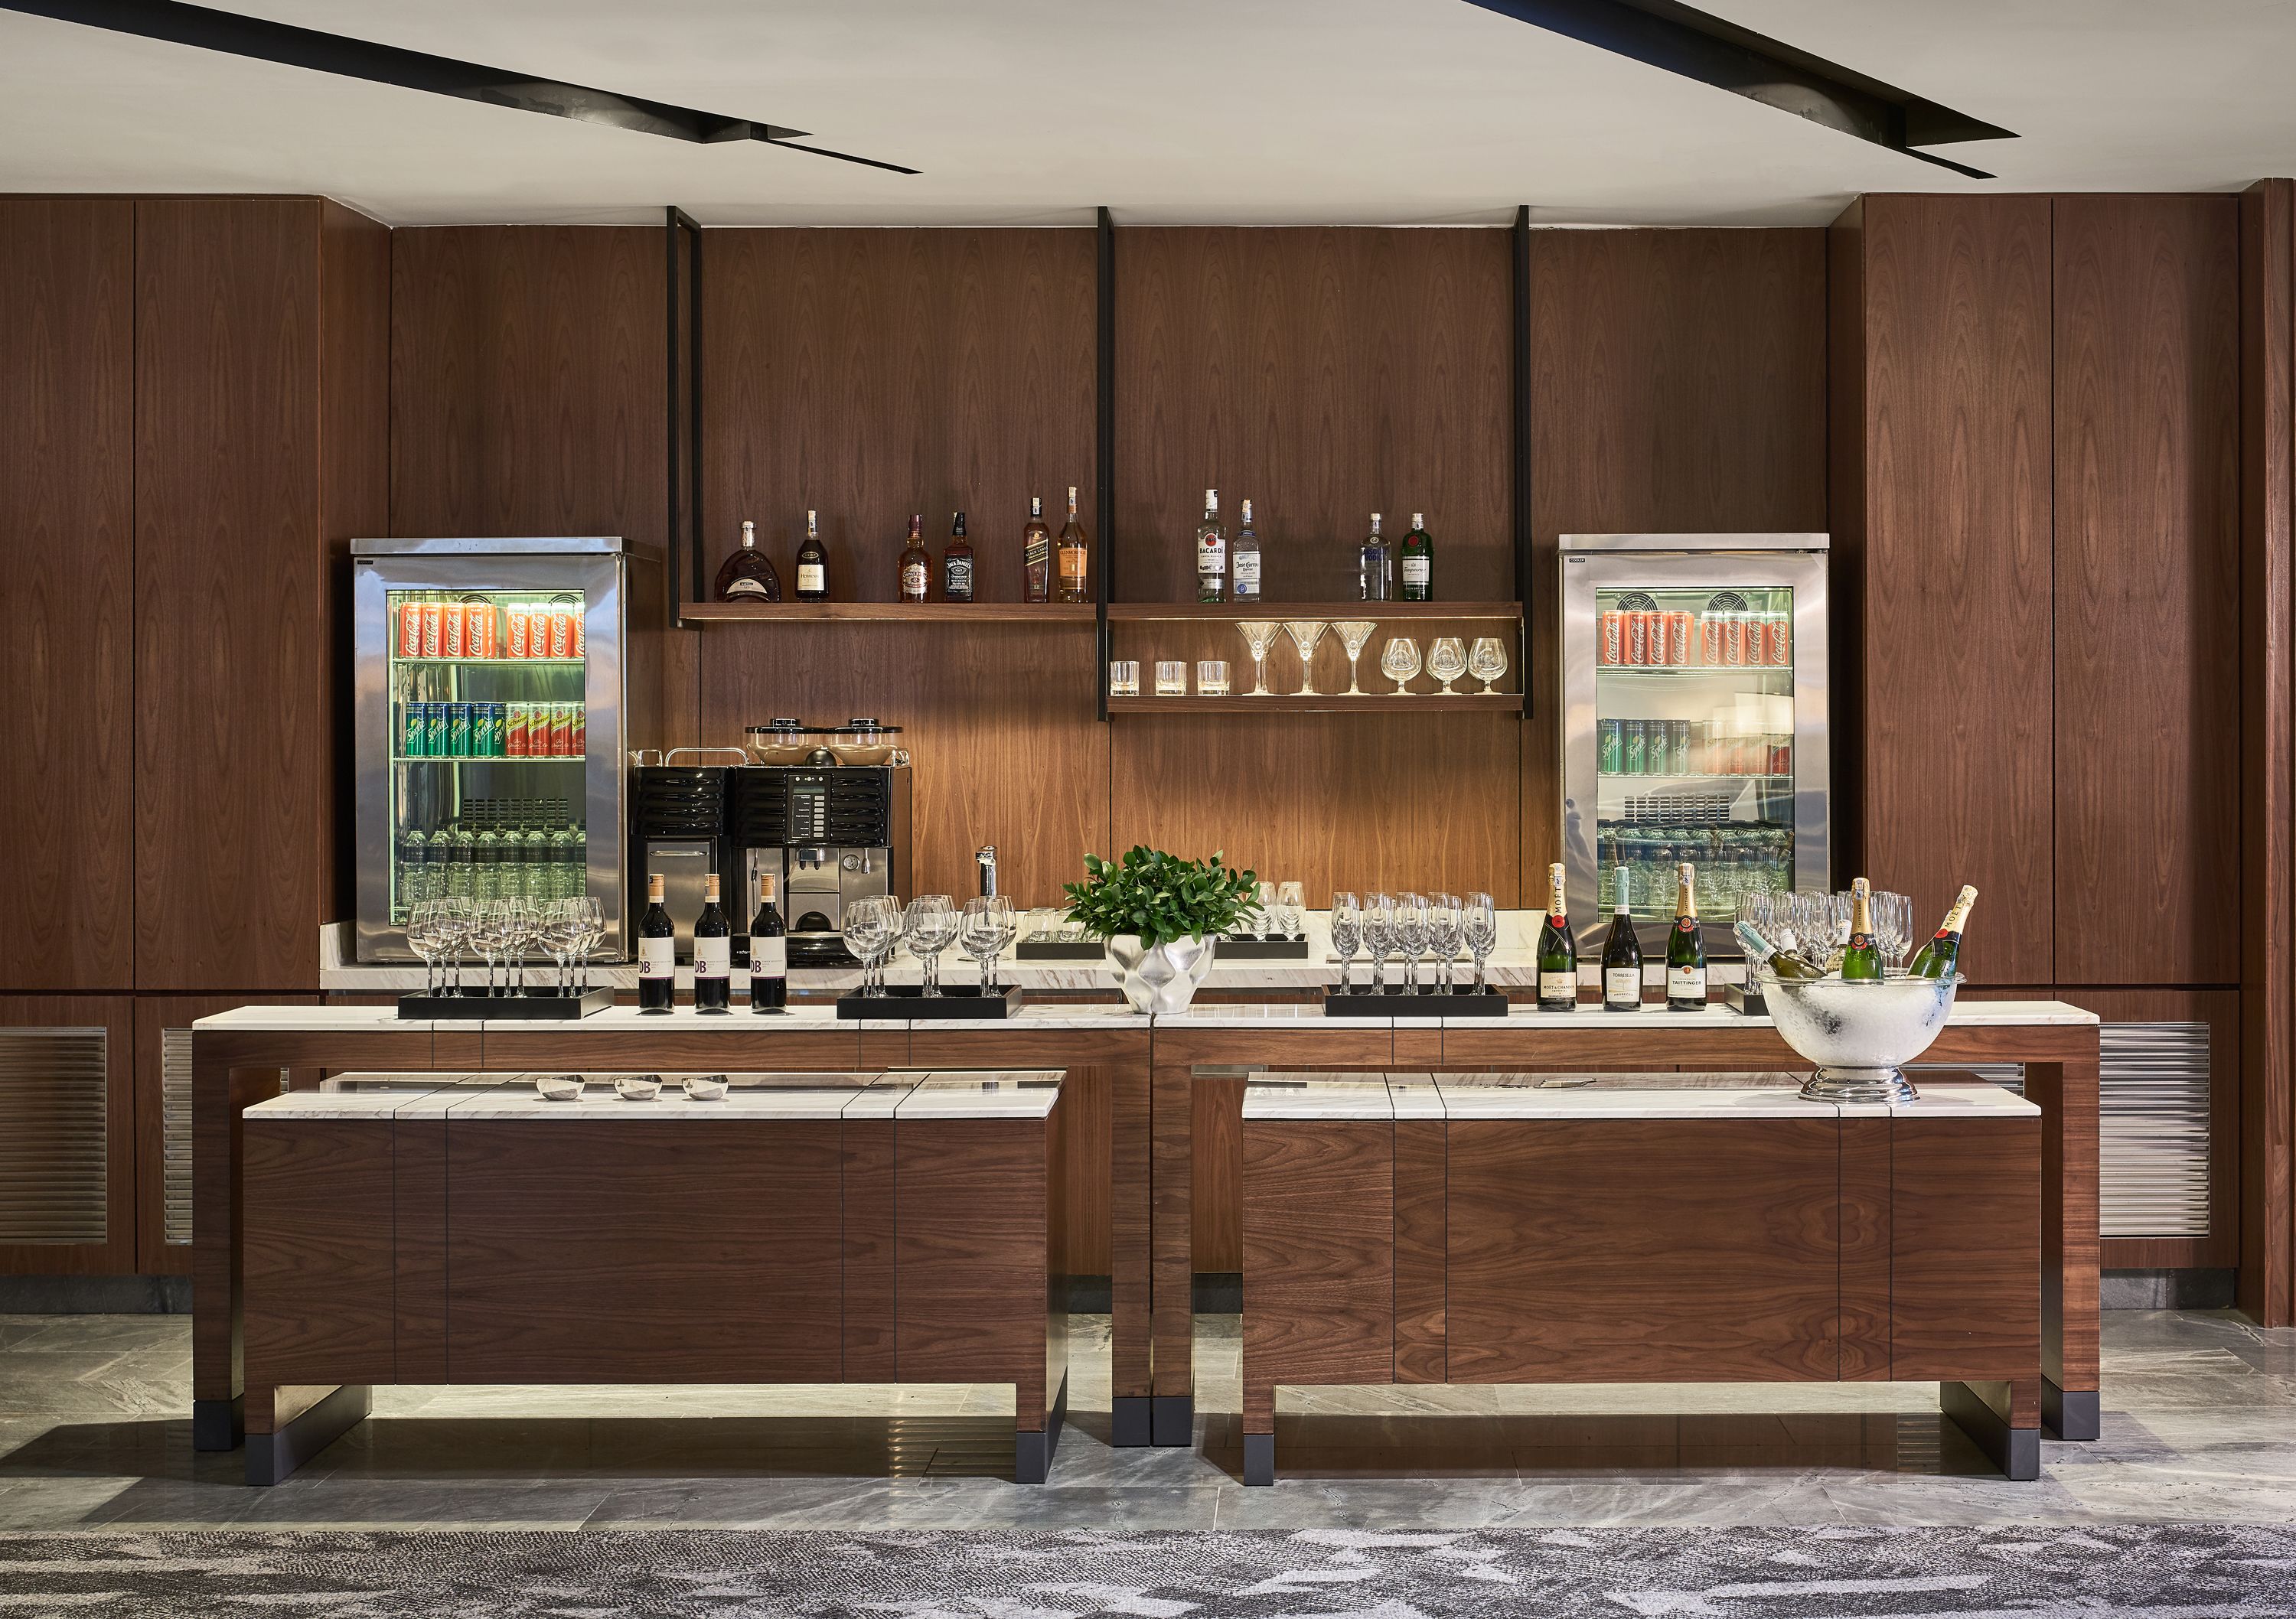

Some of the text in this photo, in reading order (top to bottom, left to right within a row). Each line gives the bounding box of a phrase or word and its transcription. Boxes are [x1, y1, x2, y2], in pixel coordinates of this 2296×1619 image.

[469, 611, 482, 656] Coca-Cola
[510, 613, 526, 656] Coca-Cola
[531, 613, 546, 656] Coca-Cola
[553, 613, 567, 656] Coca-Cola
[639, 960, 651, 973] DB
[695, 960, 706, 973] DB
[751, 959, 762, 972] DB
